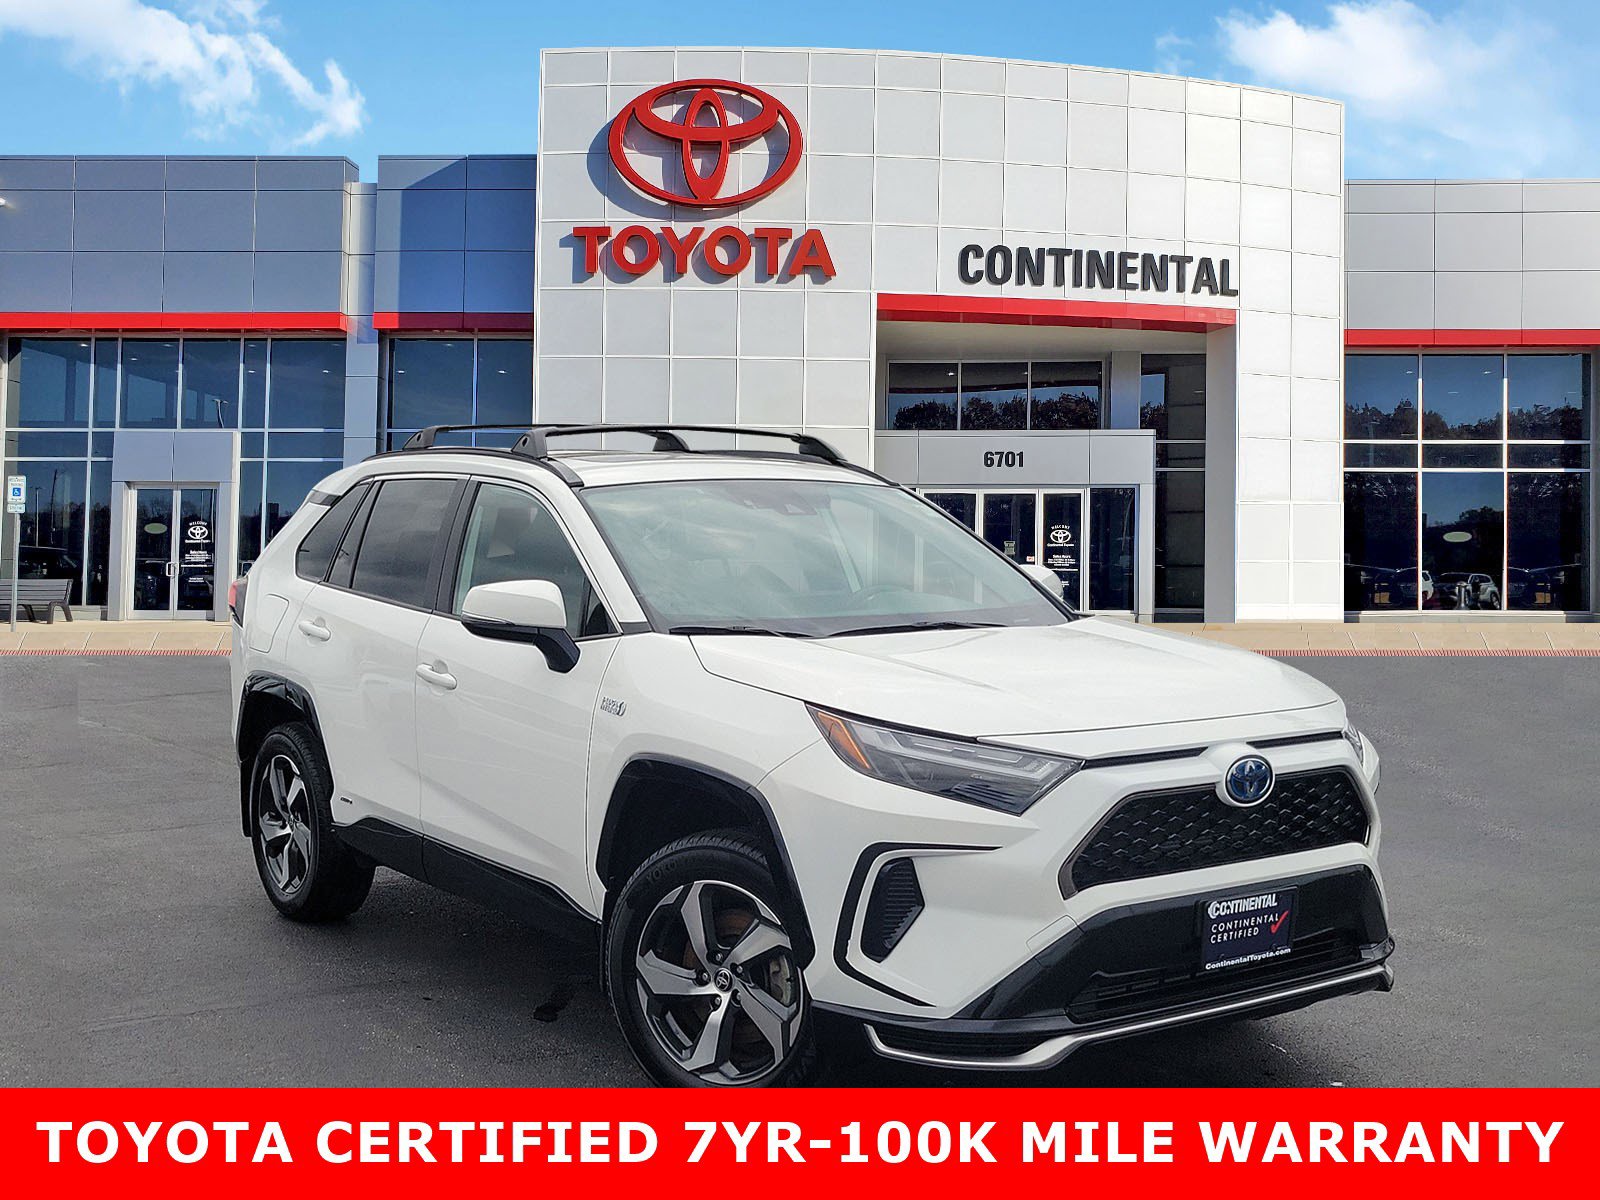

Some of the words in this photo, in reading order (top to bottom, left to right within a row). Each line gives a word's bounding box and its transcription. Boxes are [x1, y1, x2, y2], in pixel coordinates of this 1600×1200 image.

[573, 225, 837, 277] TOYOTA
[959, 244, 1239, 297] CONTINENTAL
[983, 451, 1024, 468] 6701
[1208, 893, 1278, 919] CONTINENTAL
[1211, 913, 1279, 933] CONTINENTAL
[1210, 927, 1260, 944] CERTIFIED
[1205, 948, 1291, 970] ContinentalToyota.com
